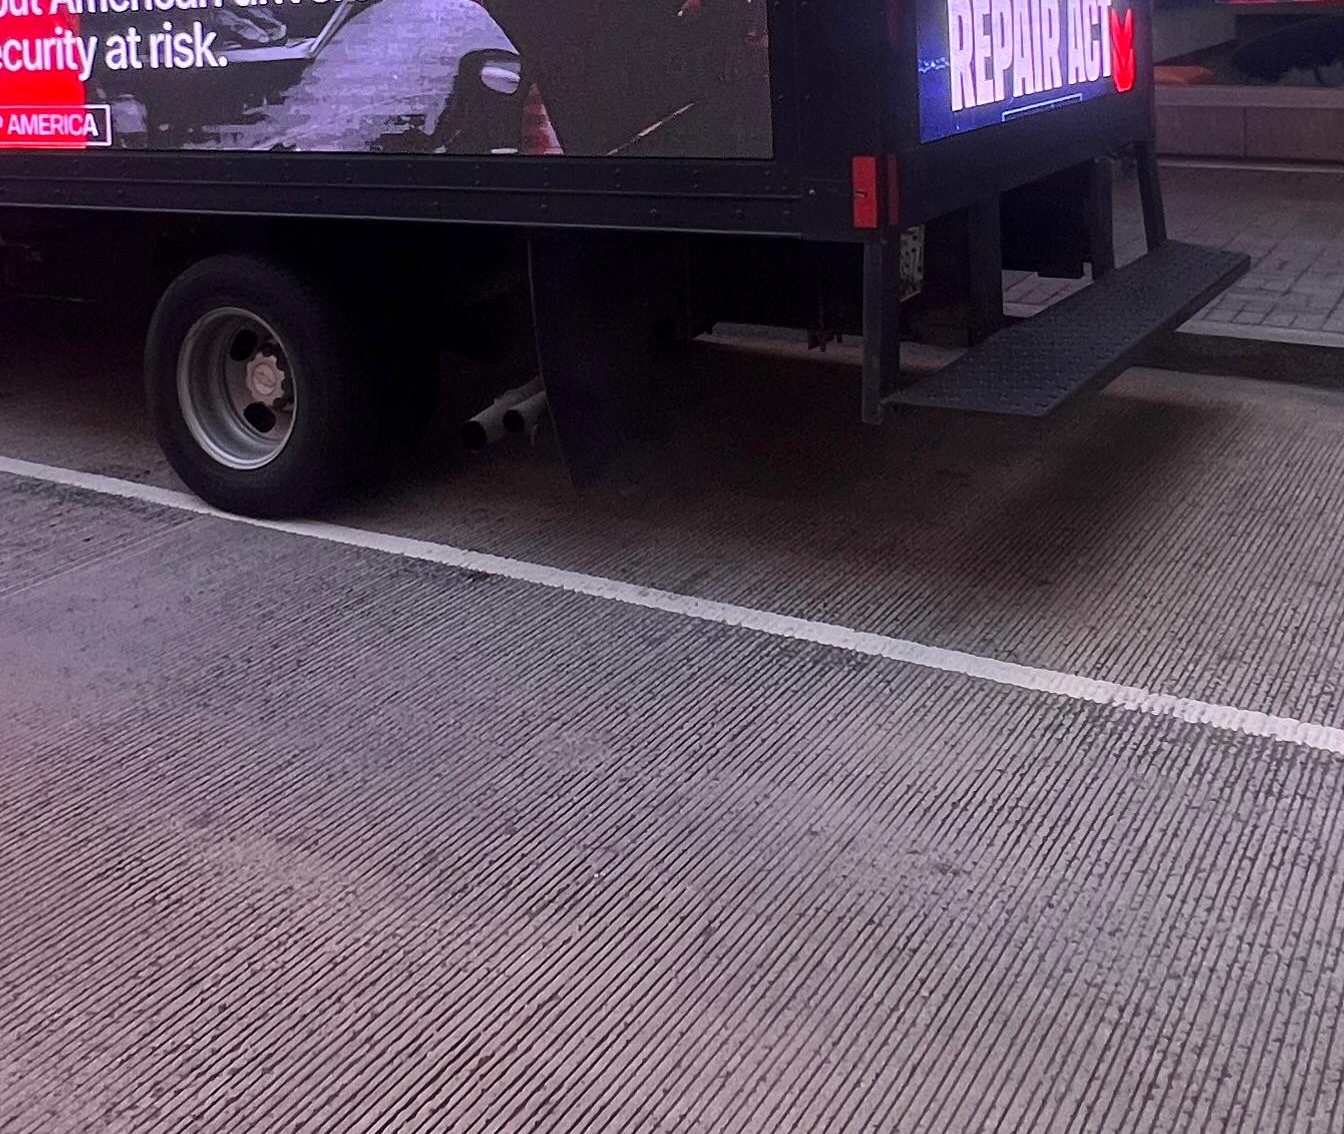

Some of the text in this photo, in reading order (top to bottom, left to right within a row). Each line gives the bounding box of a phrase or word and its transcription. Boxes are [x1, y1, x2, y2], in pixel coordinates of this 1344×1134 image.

[104, 32, 143, 69] at
[148, 21, 228, 69] risk.
[7, 113, 98, 136] AMERICA
